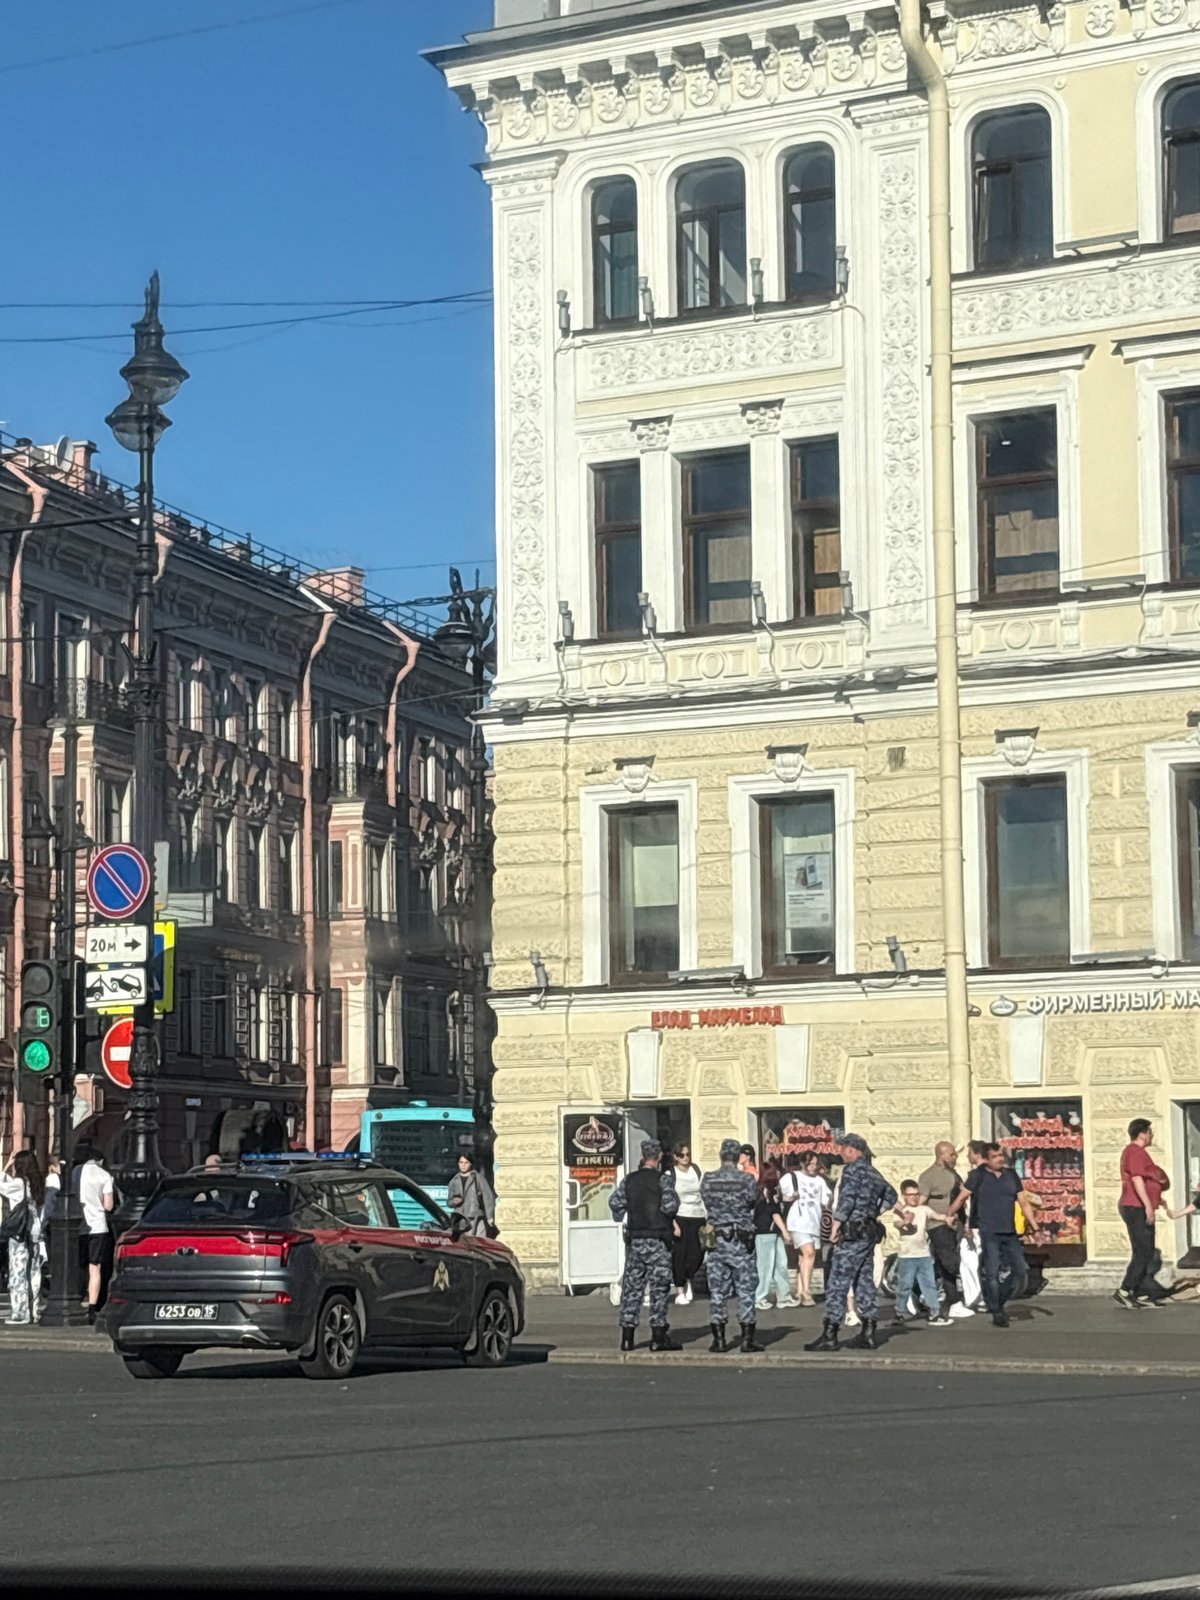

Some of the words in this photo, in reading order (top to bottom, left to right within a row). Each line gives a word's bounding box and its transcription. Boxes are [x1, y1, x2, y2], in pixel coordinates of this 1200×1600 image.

[1027, 988, 1165, 1014] ФИРМЕННЫЙ
[698, 1005, 784, 1027] МАРМЕЛАД
[786, 1123, 826, 1138] КЛАД
[1020, 1118, 1064, 1133] КЛАД
[158, 1305, 187, 1318] 6253
[204, 1304, 214, 1315] 15
